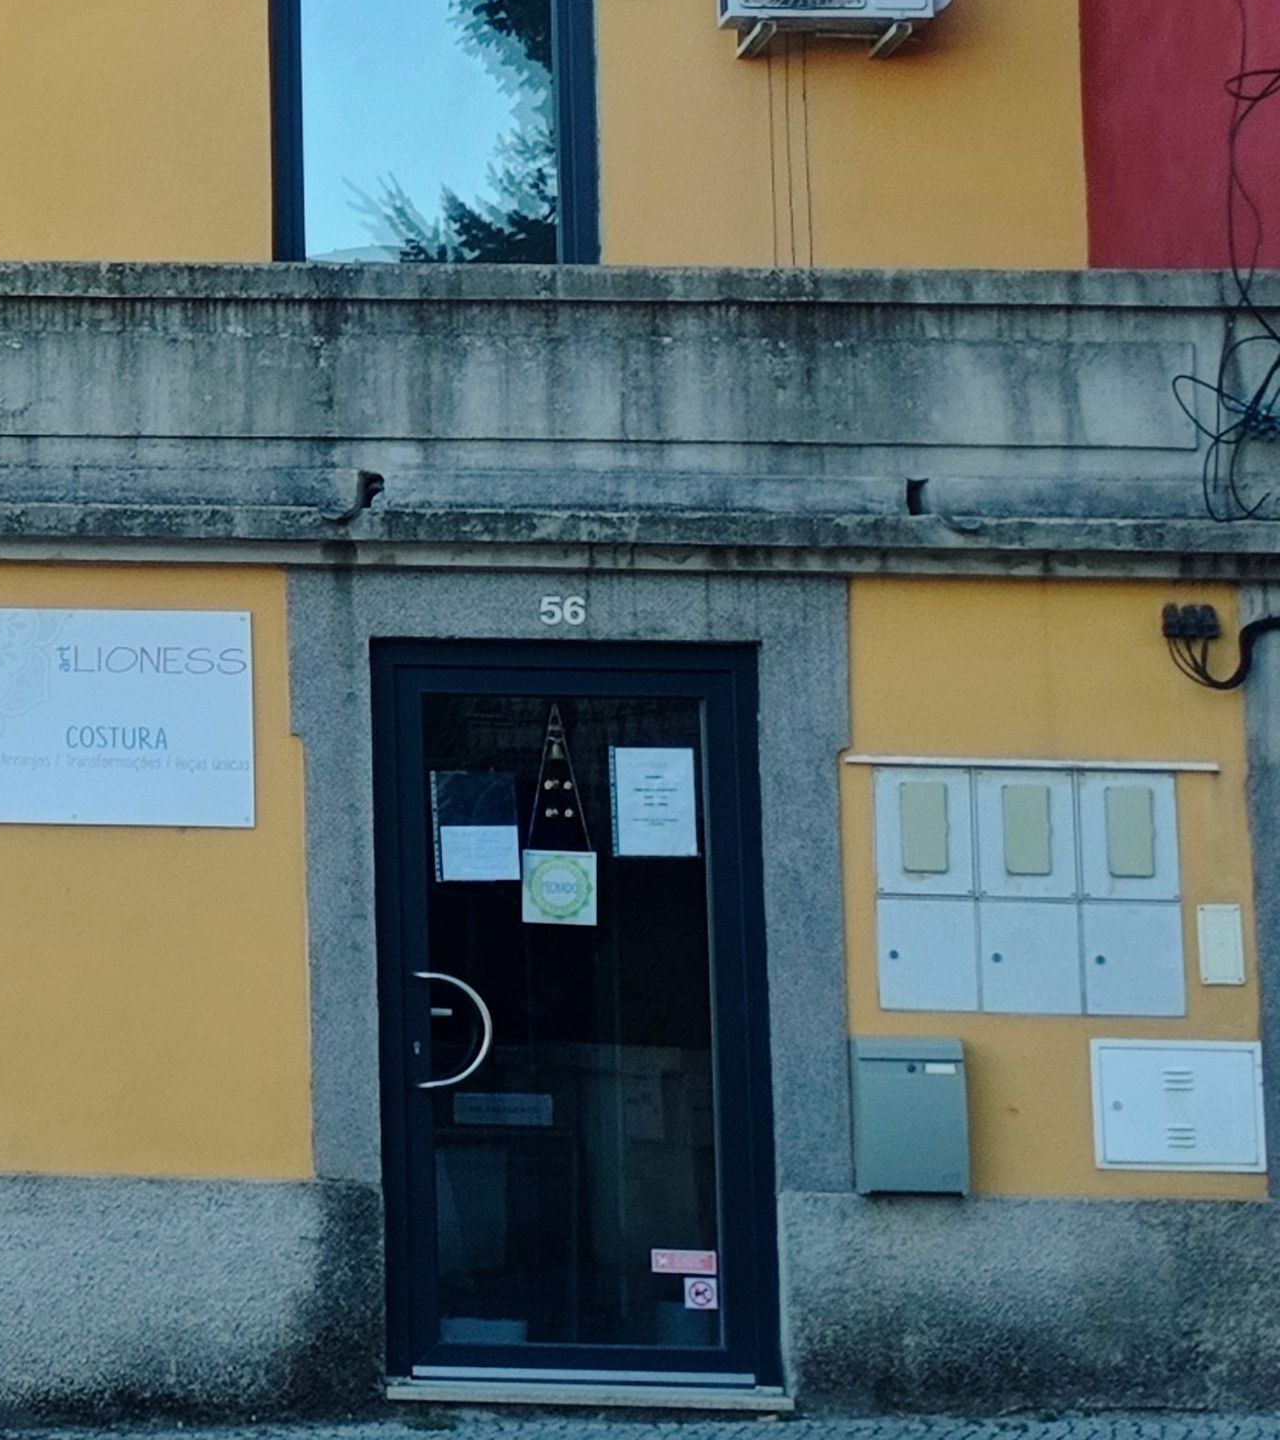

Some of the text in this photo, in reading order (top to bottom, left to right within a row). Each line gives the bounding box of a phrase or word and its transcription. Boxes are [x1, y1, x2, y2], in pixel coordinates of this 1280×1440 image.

[540, 596, 585, 625] 56
[73, 646, 247, 675] LIONESS
[66, 725, 168, 750] COSTURA
